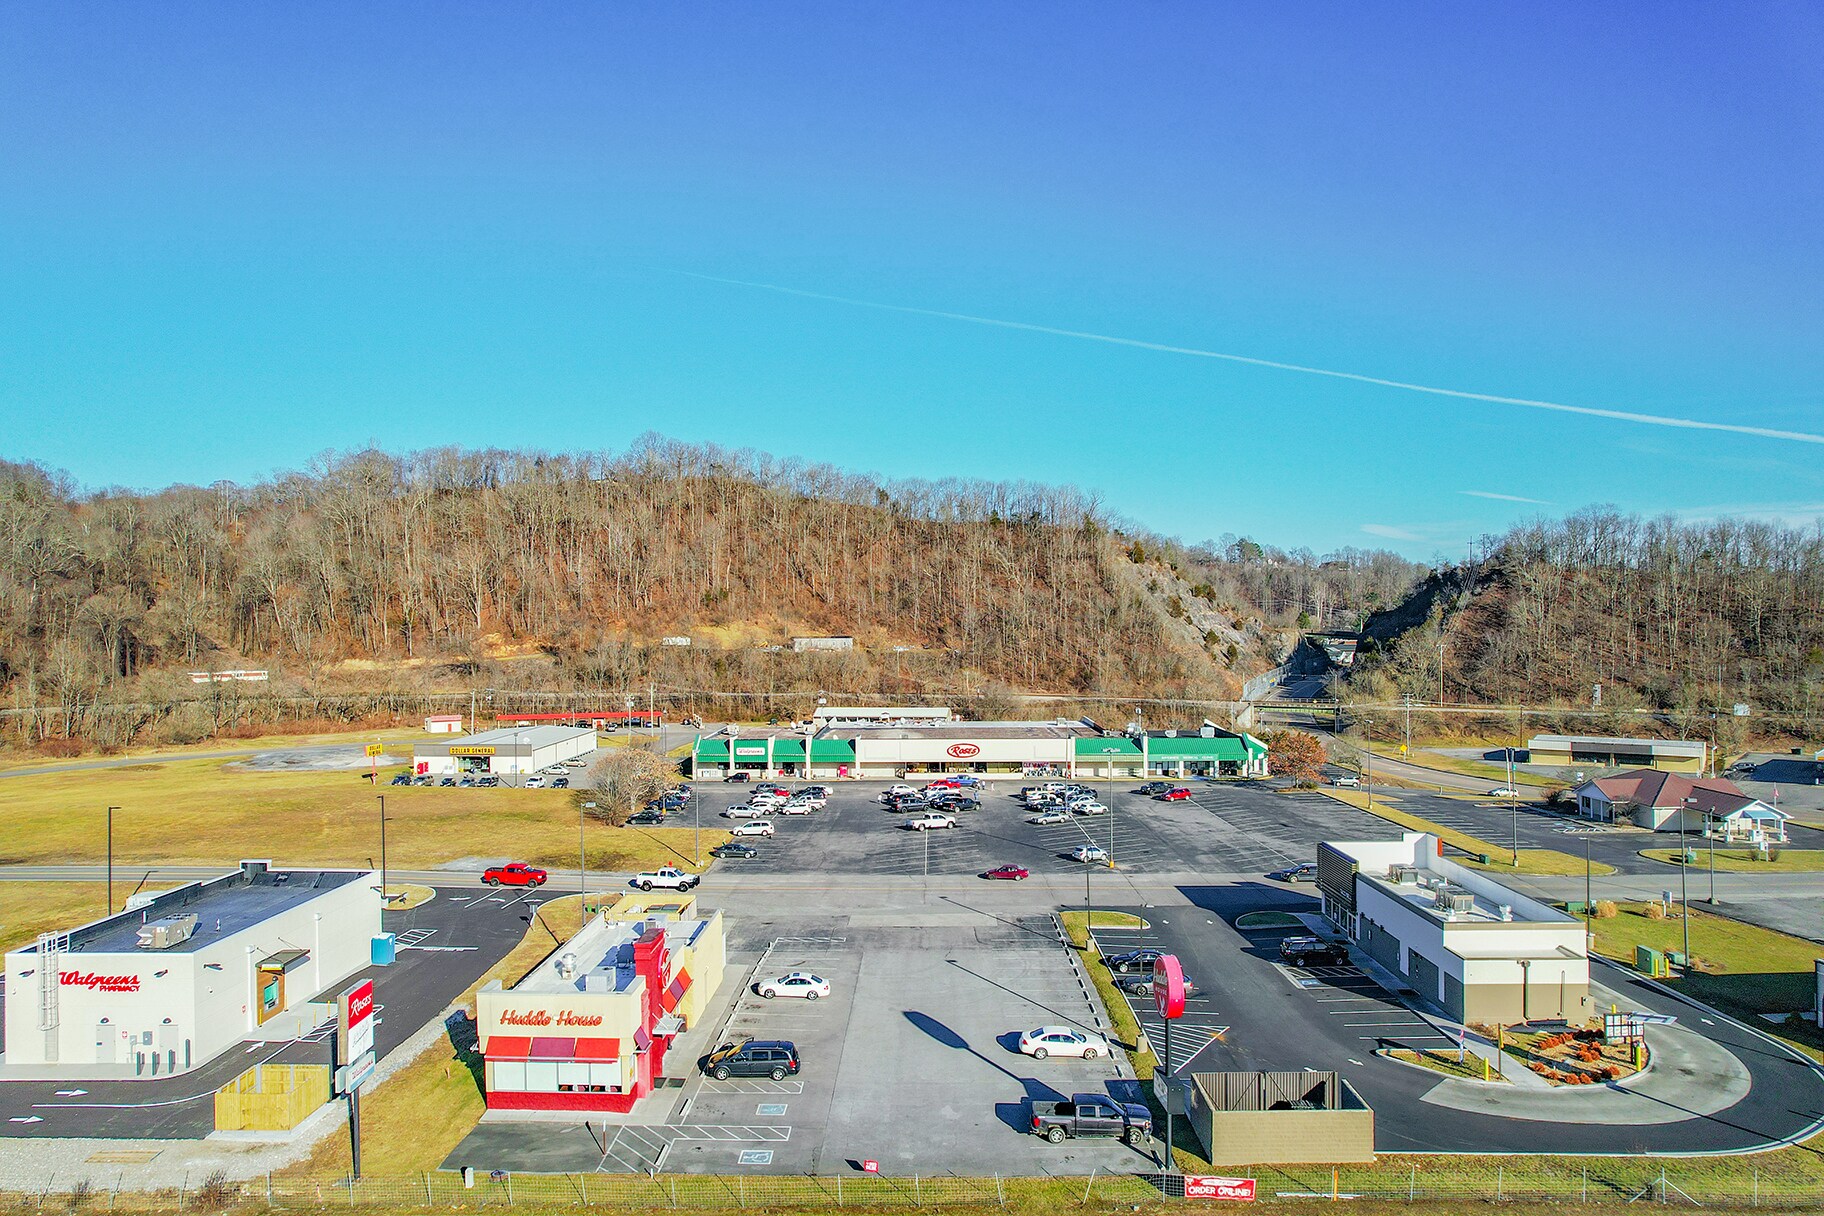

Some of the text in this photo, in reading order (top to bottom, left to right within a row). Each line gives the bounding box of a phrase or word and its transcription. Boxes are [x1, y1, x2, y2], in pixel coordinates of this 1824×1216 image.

[59, 970, 140, 990] Walgreens
[500, 1009, 603, 1027] Huddle House
[1188, 1186, 1216, 1195] ORDER
